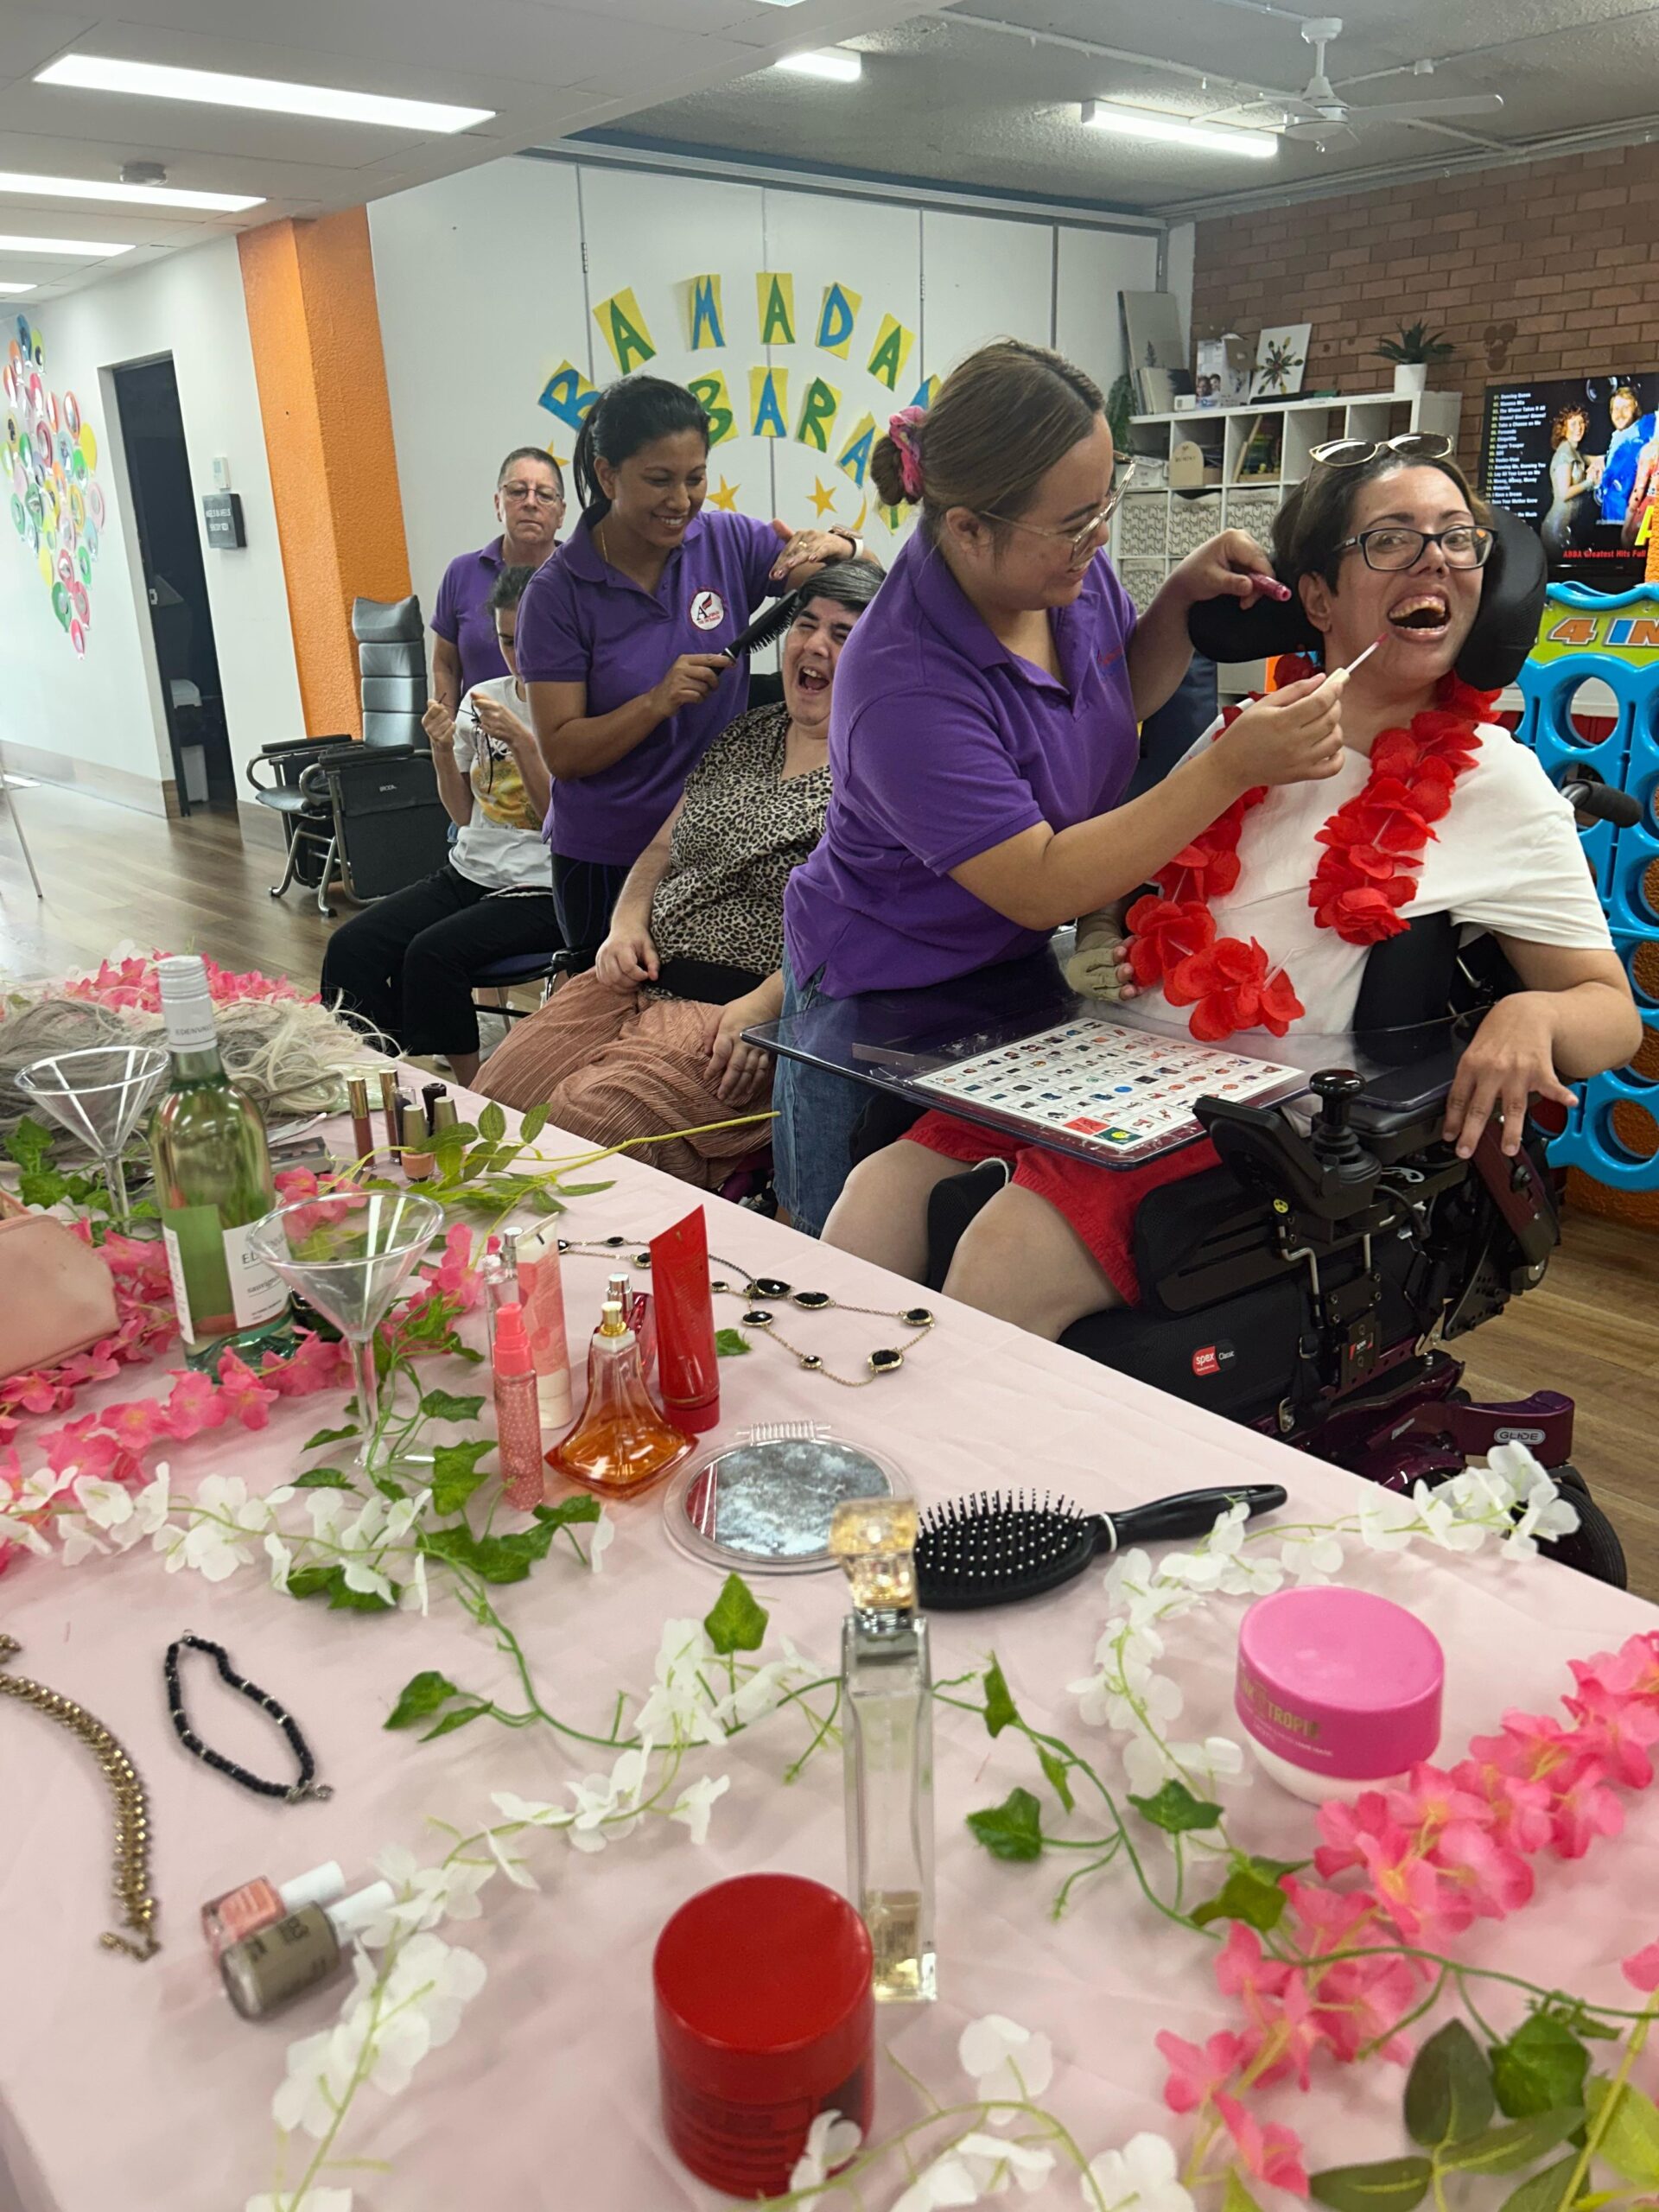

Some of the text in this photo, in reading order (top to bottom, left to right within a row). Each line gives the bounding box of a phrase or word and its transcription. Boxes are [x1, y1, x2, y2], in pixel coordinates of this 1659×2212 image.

[1549, 617, 1598, 645] 4
[1196, 1352, 1215, 1366] spex
[1499, 1431, 1539, 1441] GLIDE
